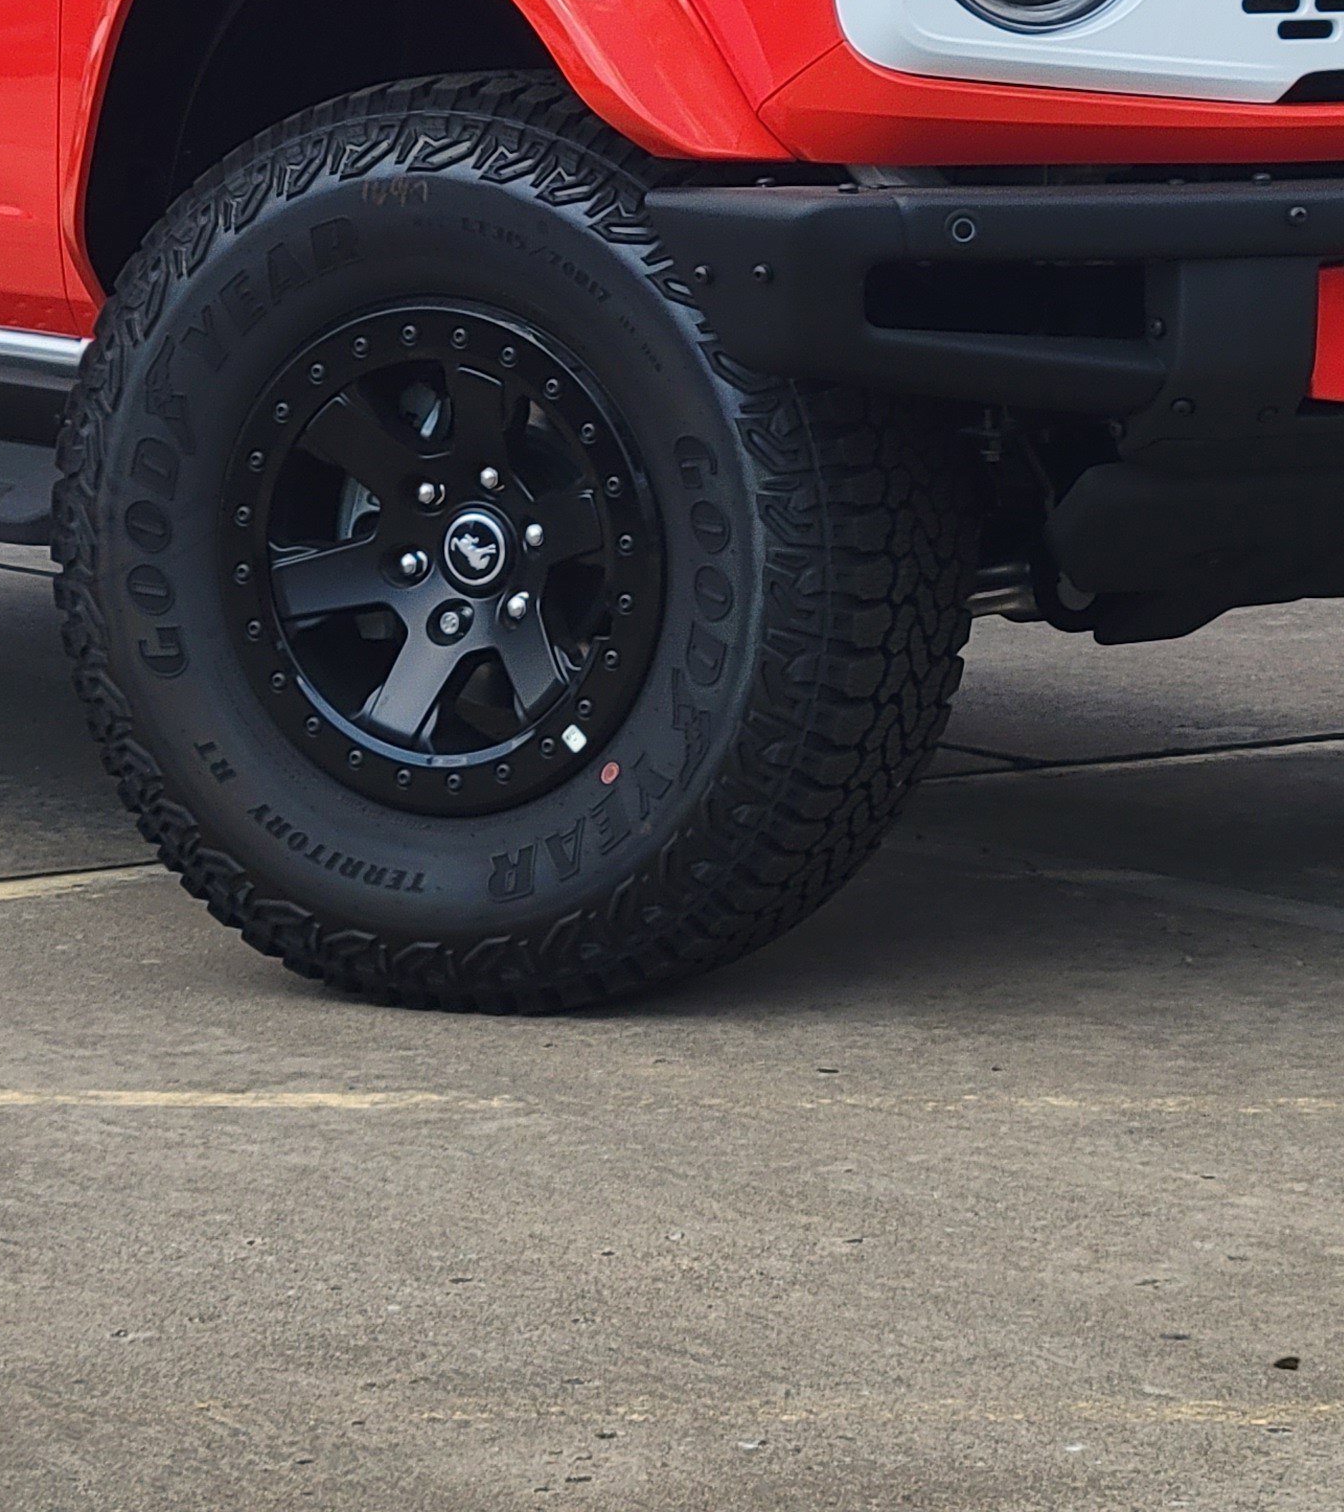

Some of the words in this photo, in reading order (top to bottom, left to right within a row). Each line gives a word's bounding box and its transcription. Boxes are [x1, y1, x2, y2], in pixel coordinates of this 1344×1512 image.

[123, 214, 363, 680] GOODYEAR
[192, 740, 237, 784] RT
[488, 433, 734, 904] GOODYEAR
[246, 803, 426, 893] TERRITORY
